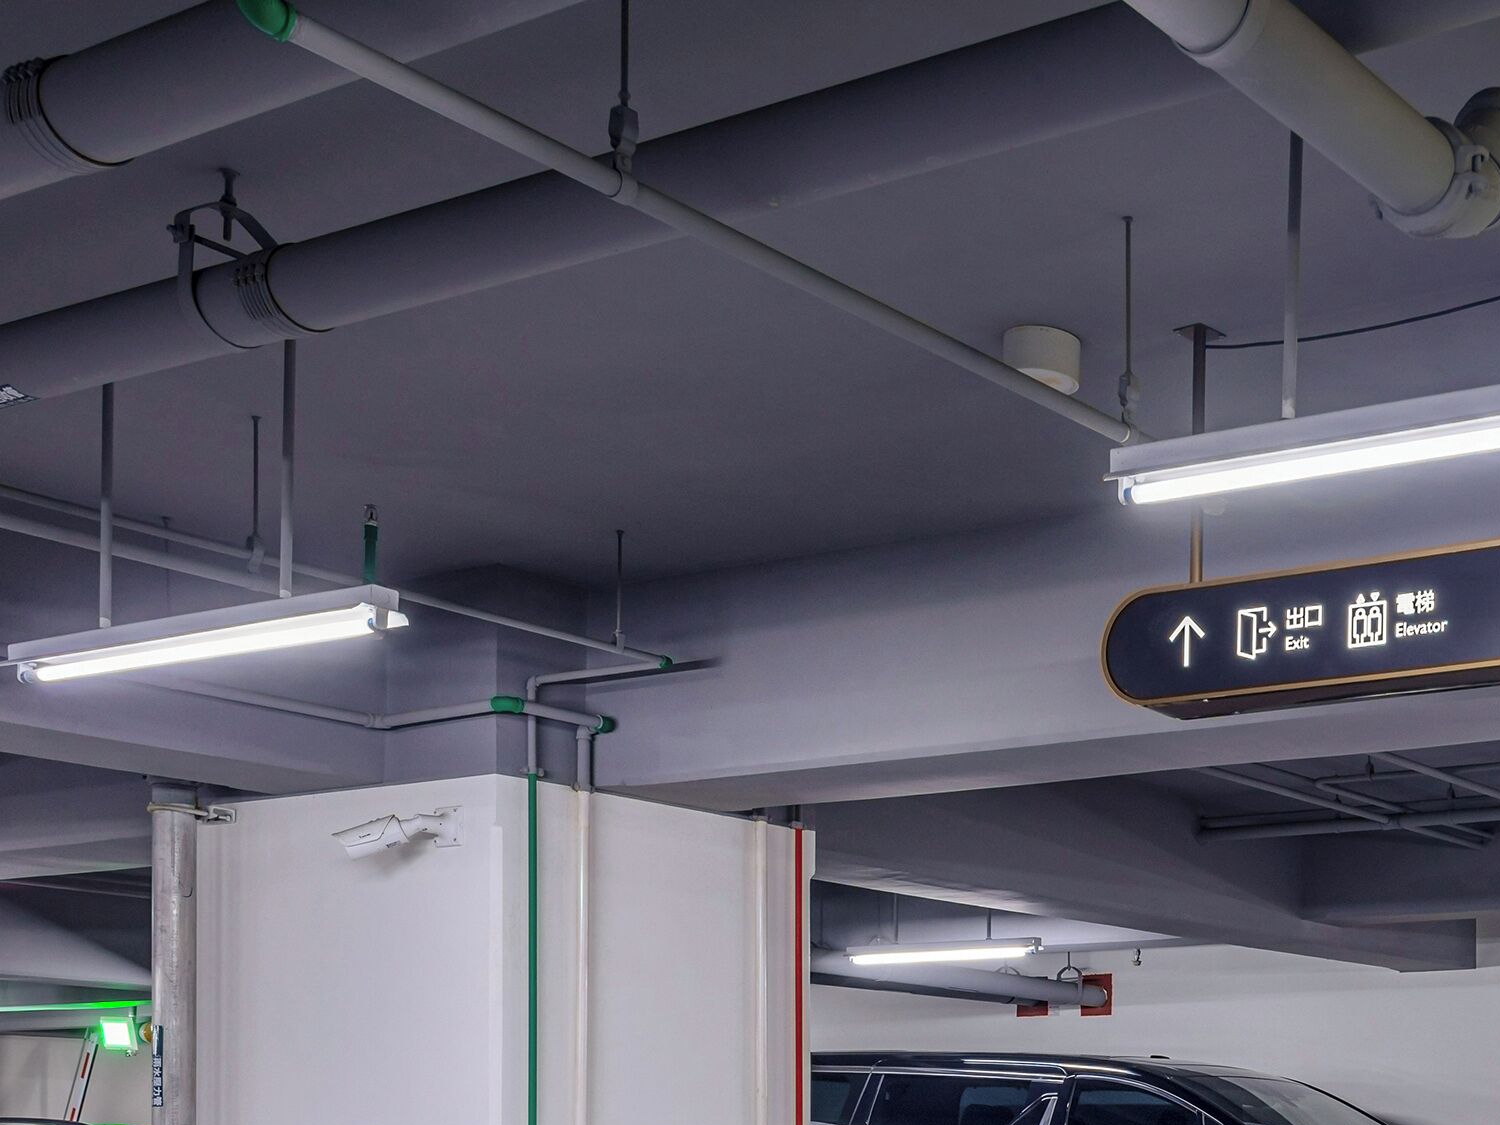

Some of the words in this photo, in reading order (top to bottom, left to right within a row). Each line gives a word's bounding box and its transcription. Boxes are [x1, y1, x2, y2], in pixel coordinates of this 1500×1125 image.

[1396, 589, 1435, 615] 電梯
[1286, 604, 1322, 630] 出口
[1395, 620, 1448, 638] Elevator
[1285, 635, 1310, 650] Exit
